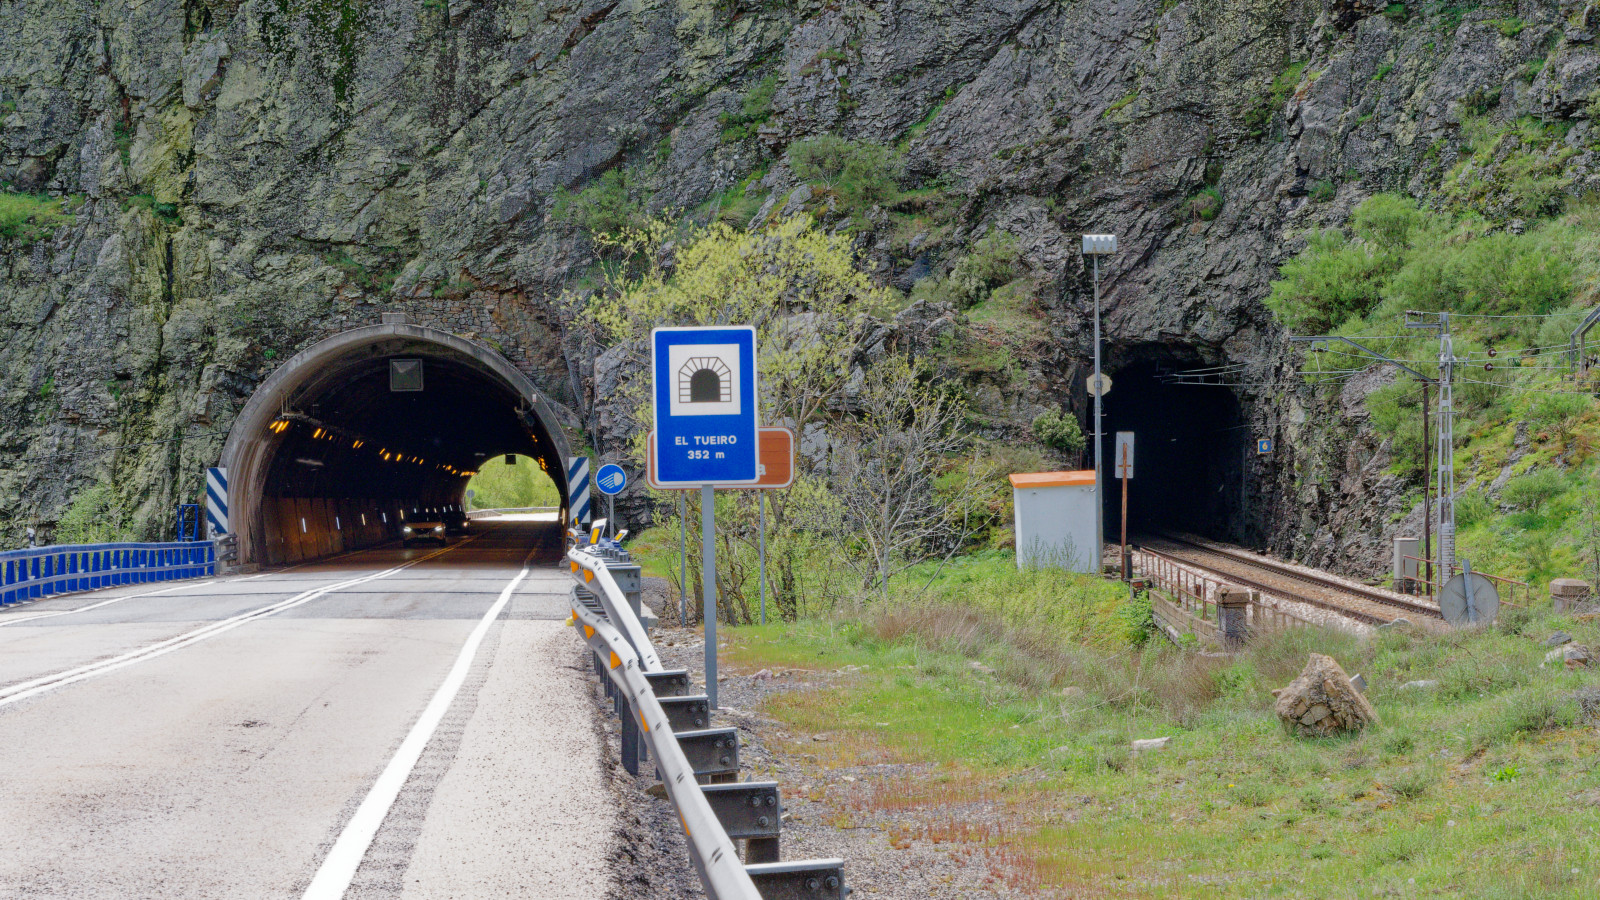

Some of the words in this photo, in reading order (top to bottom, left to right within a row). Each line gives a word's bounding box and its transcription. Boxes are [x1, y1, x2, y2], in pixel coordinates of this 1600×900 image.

[675, 436, 688, 446] EL
[694, 435, 737, 445] TUEIRO
[687, 450, 710, 459] 352
[715, 451, 725, 459] m
